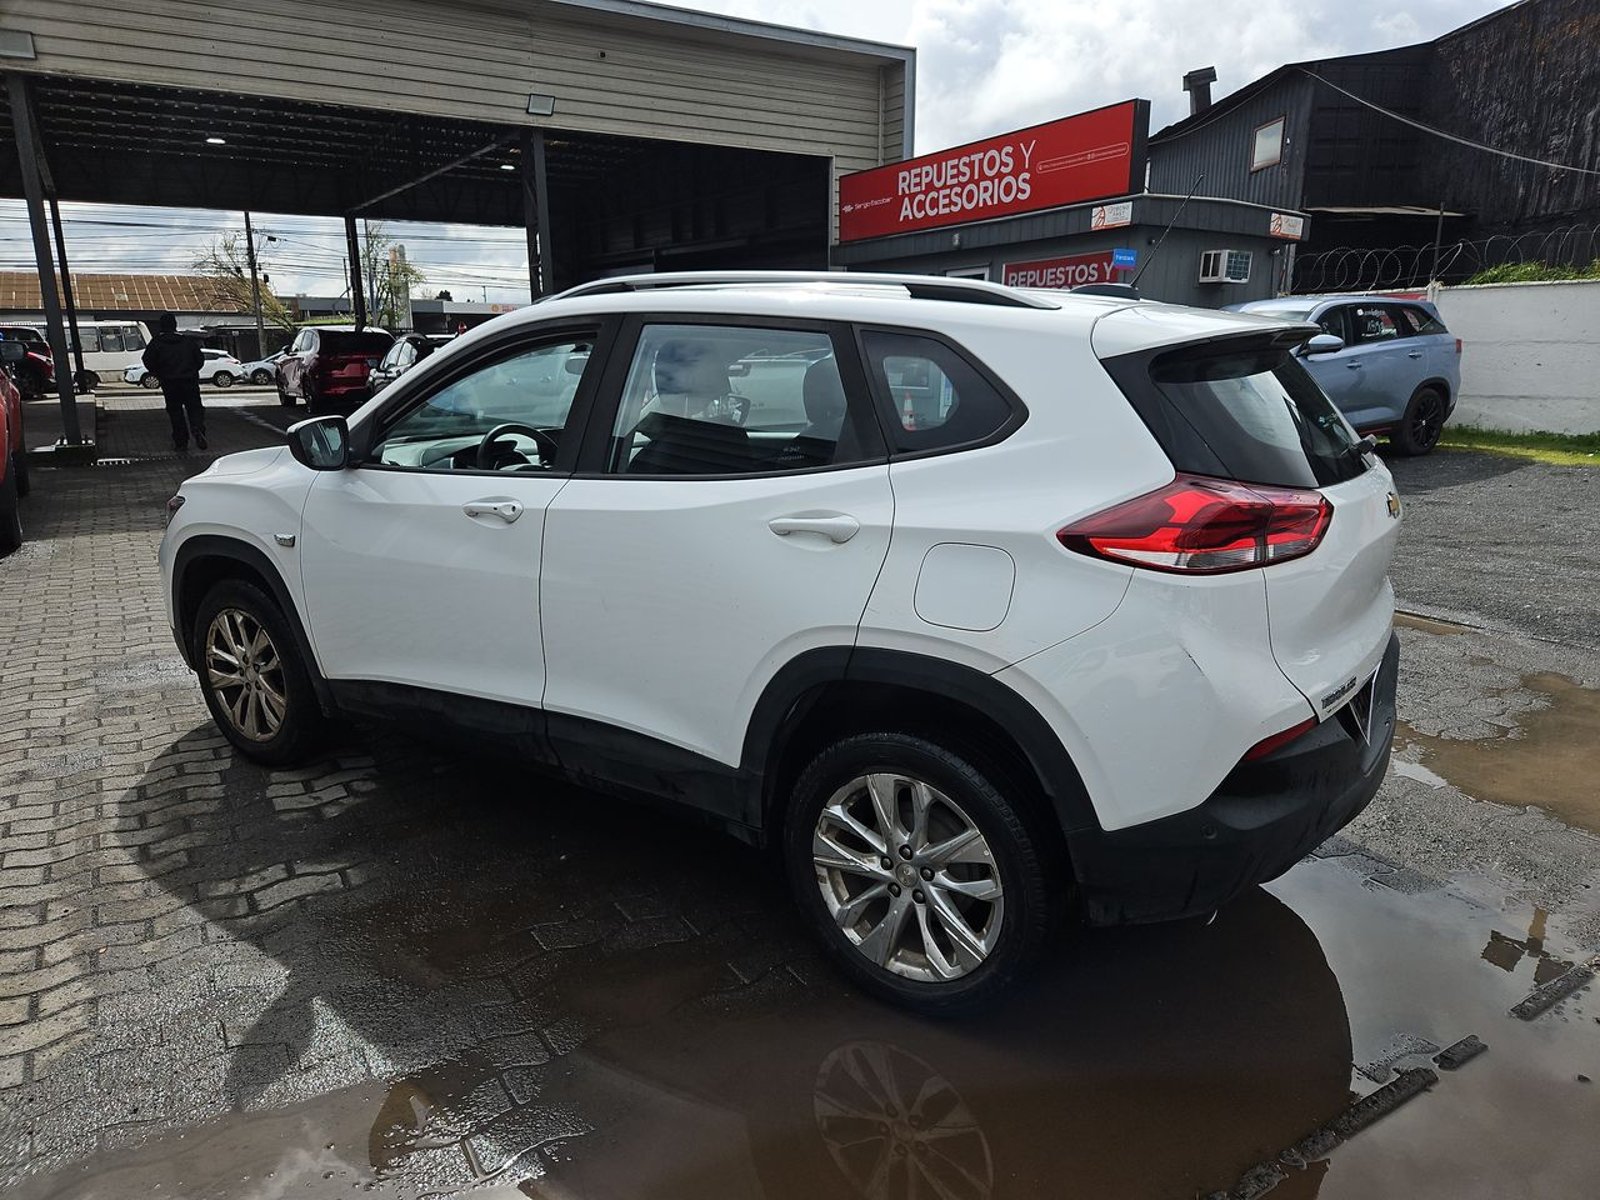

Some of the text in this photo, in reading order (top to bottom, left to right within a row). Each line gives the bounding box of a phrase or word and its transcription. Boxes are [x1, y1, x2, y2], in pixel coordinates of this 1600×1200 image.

[898, 145, 1014, 195] REPUESTOS
[1020, 139, 1036, 169] Y
[899, 172, 1031, 221] ACCESORIOS
[1008, 261, 1114, 288] REPUESTOS Y
